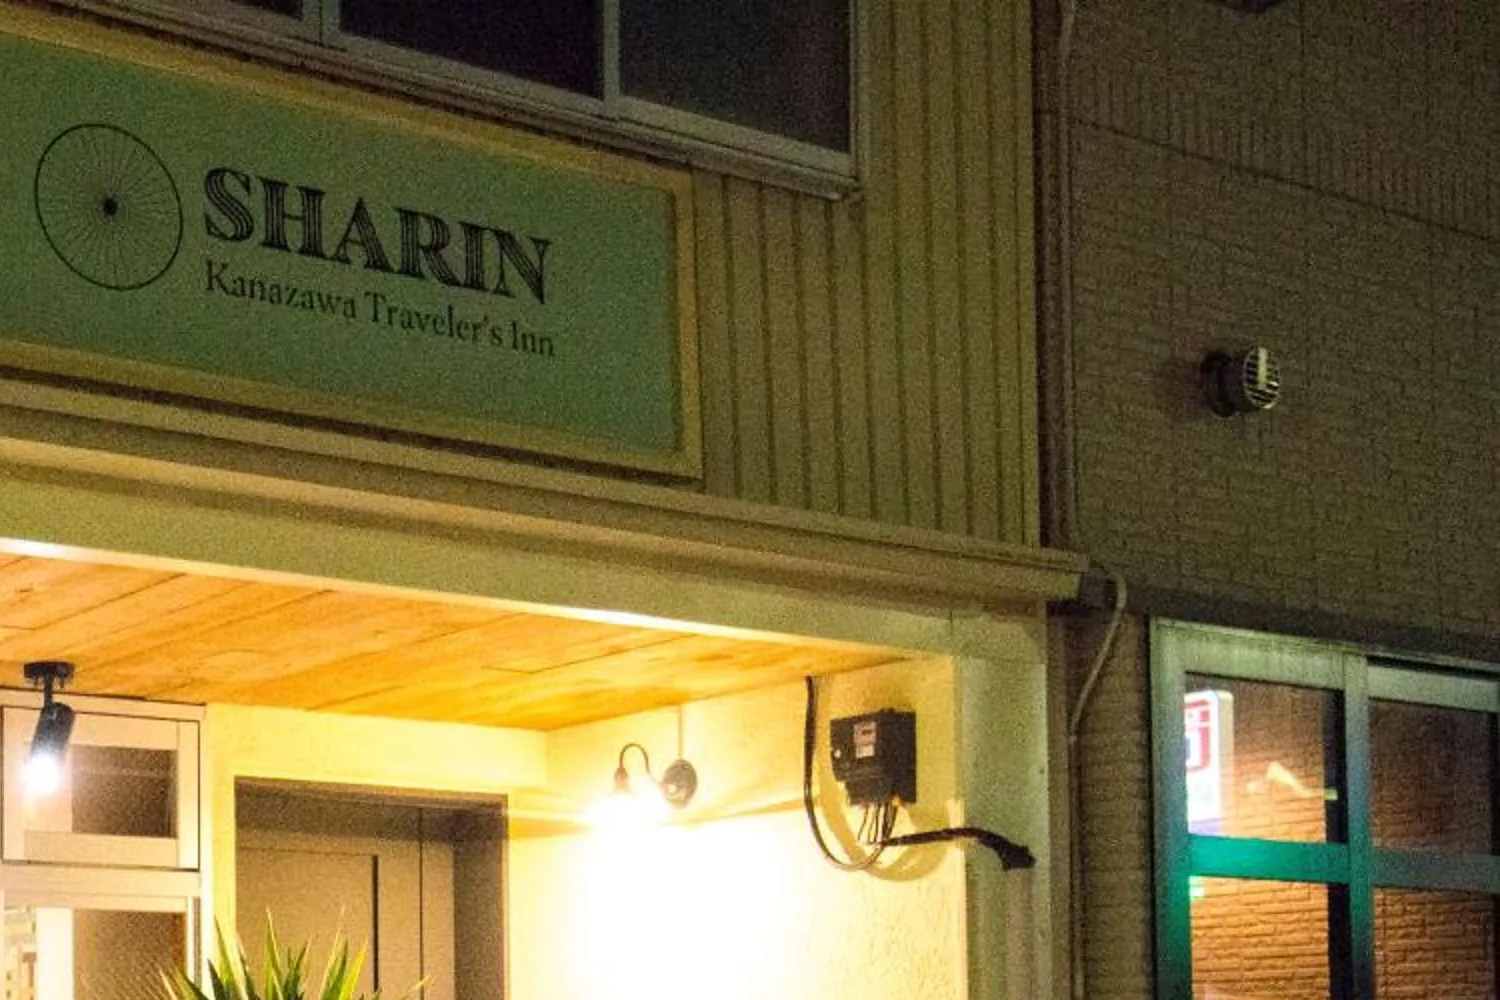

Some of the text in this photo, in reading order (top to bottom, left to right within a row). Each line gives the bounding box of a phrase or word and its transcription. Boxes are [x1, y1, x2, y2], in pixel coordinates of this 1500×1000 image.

[204, 167, 553, 305] SHARIN
[205, 258, 556, 357] Kanazawa Traveler's Inn
